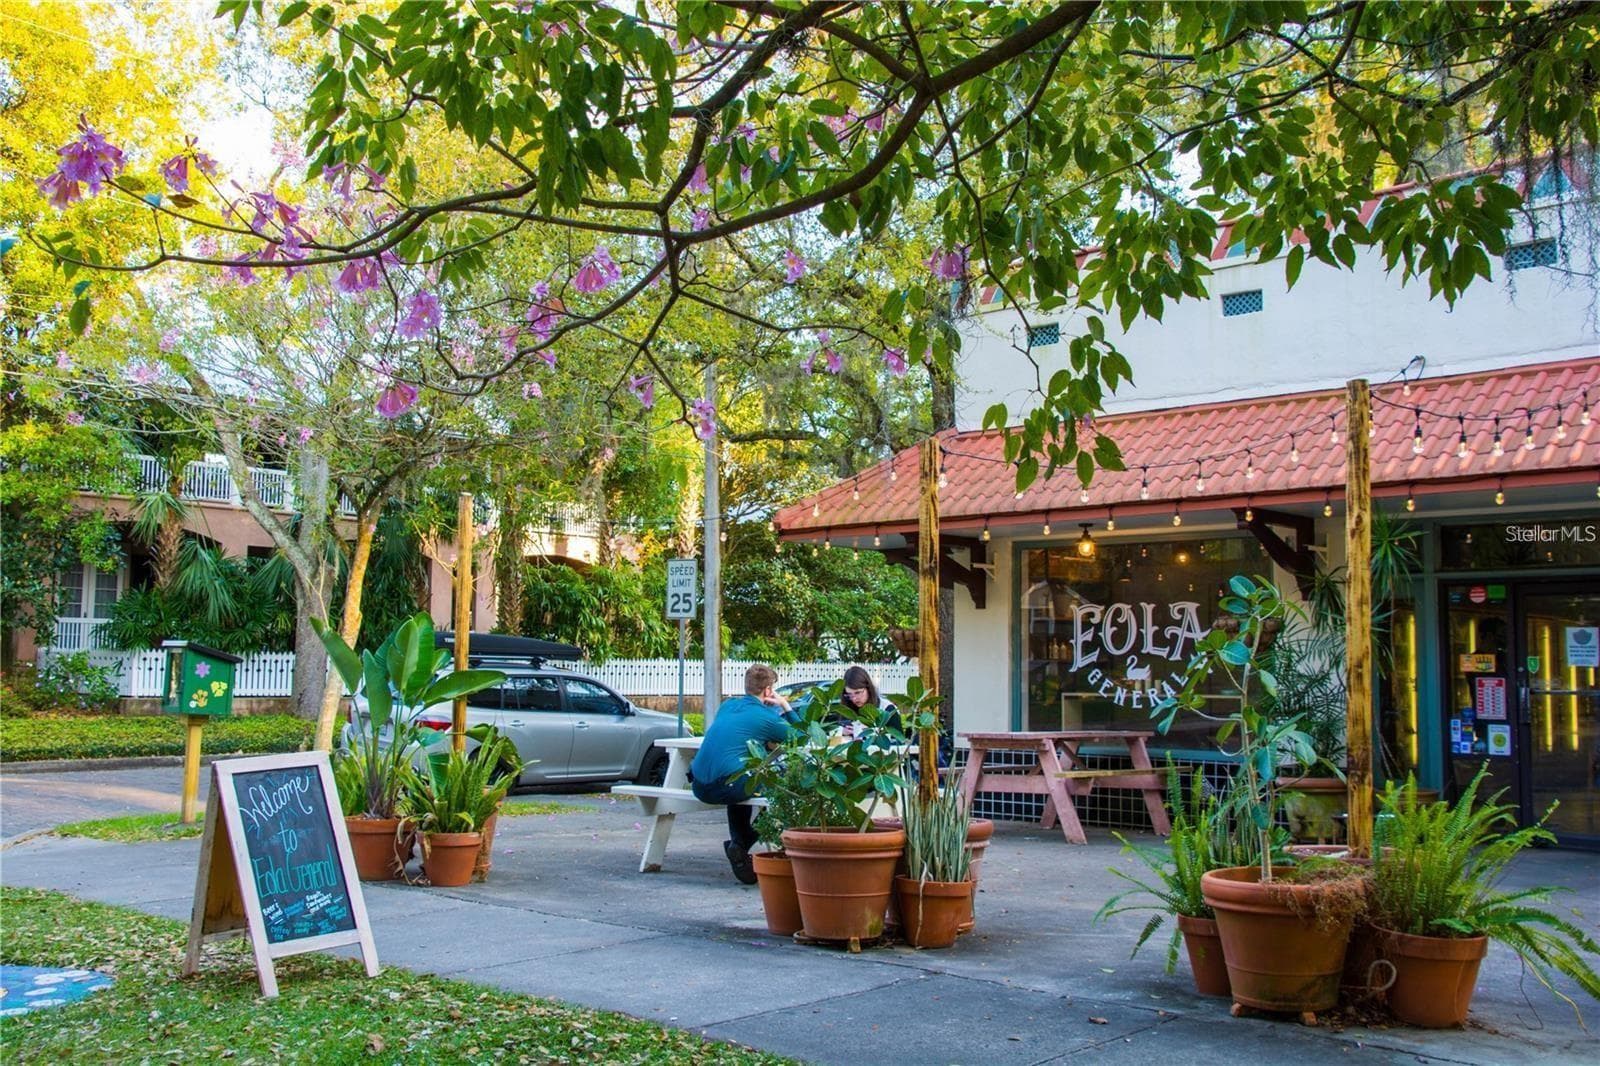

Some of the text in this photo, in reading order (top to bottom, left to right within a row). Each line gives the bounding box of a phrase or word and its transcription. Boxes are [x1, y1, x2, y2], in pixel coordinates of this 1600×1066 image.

[670, 566, 695, 576] SPEED
[672, 579, 692, 588] LIMIT
[670, 593, 693, 613] 25
[1068, 602, 1213, 674] EOLA
[1087, 668, 1189, 708] GENERAL
[239, 775, 313, 828] Welcome
[278, 821, 298, 852] to
[286, 843, 337, 892] General
